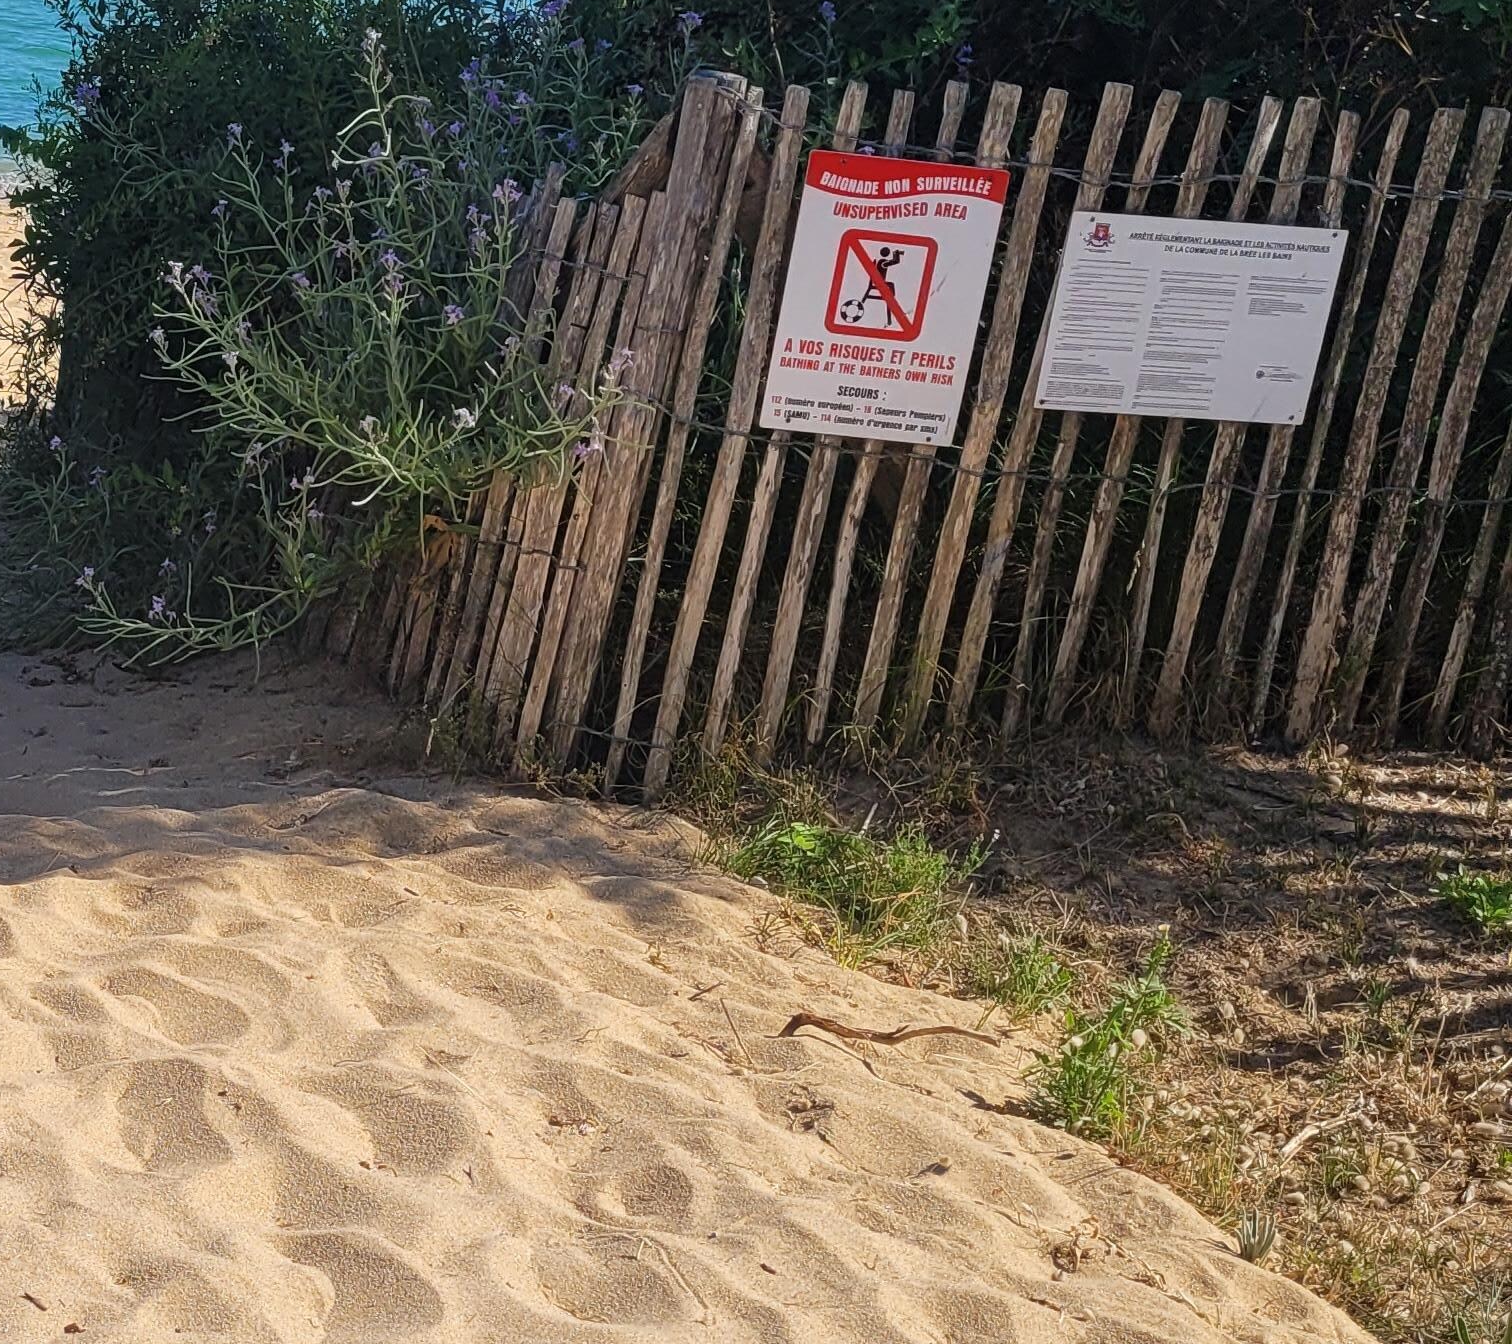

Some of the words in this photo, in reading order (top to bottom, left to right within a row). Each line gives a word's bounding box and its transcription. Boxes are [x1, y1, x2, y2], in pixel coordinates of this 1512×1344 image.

[820, 171, 880, 195] BAIGNADE
[884, 178, 911, 194] NON
[916, 176, 992, 195] SURVEILLÉE
[833, 201, 928, 220] UNSUPERVISED
[934, 202, 968, 220] AREA
[1175, 246, 1184, 254] LA
[1230, 249, 1238, 257] LA
[784, 338, 793, 353] A
[799, 339, 824, 356] VOS
[829, 342, 885, 363] RISQUES
[890, 349, 906, 365] ET
[910, 351, 956, 370] PERILS
[779, 356, 820, 371] BATHING
[823, 361, 835, 372] AT
[838, 363, 856, 375] THE
[859, 365, 901, 380] BATHERS
[904, 370, 928, 383] OWN
[930, 373, 954, 386] RISK
[771, 395, 782, 404] 112
[837, 385, 880, 400] SECOURS
